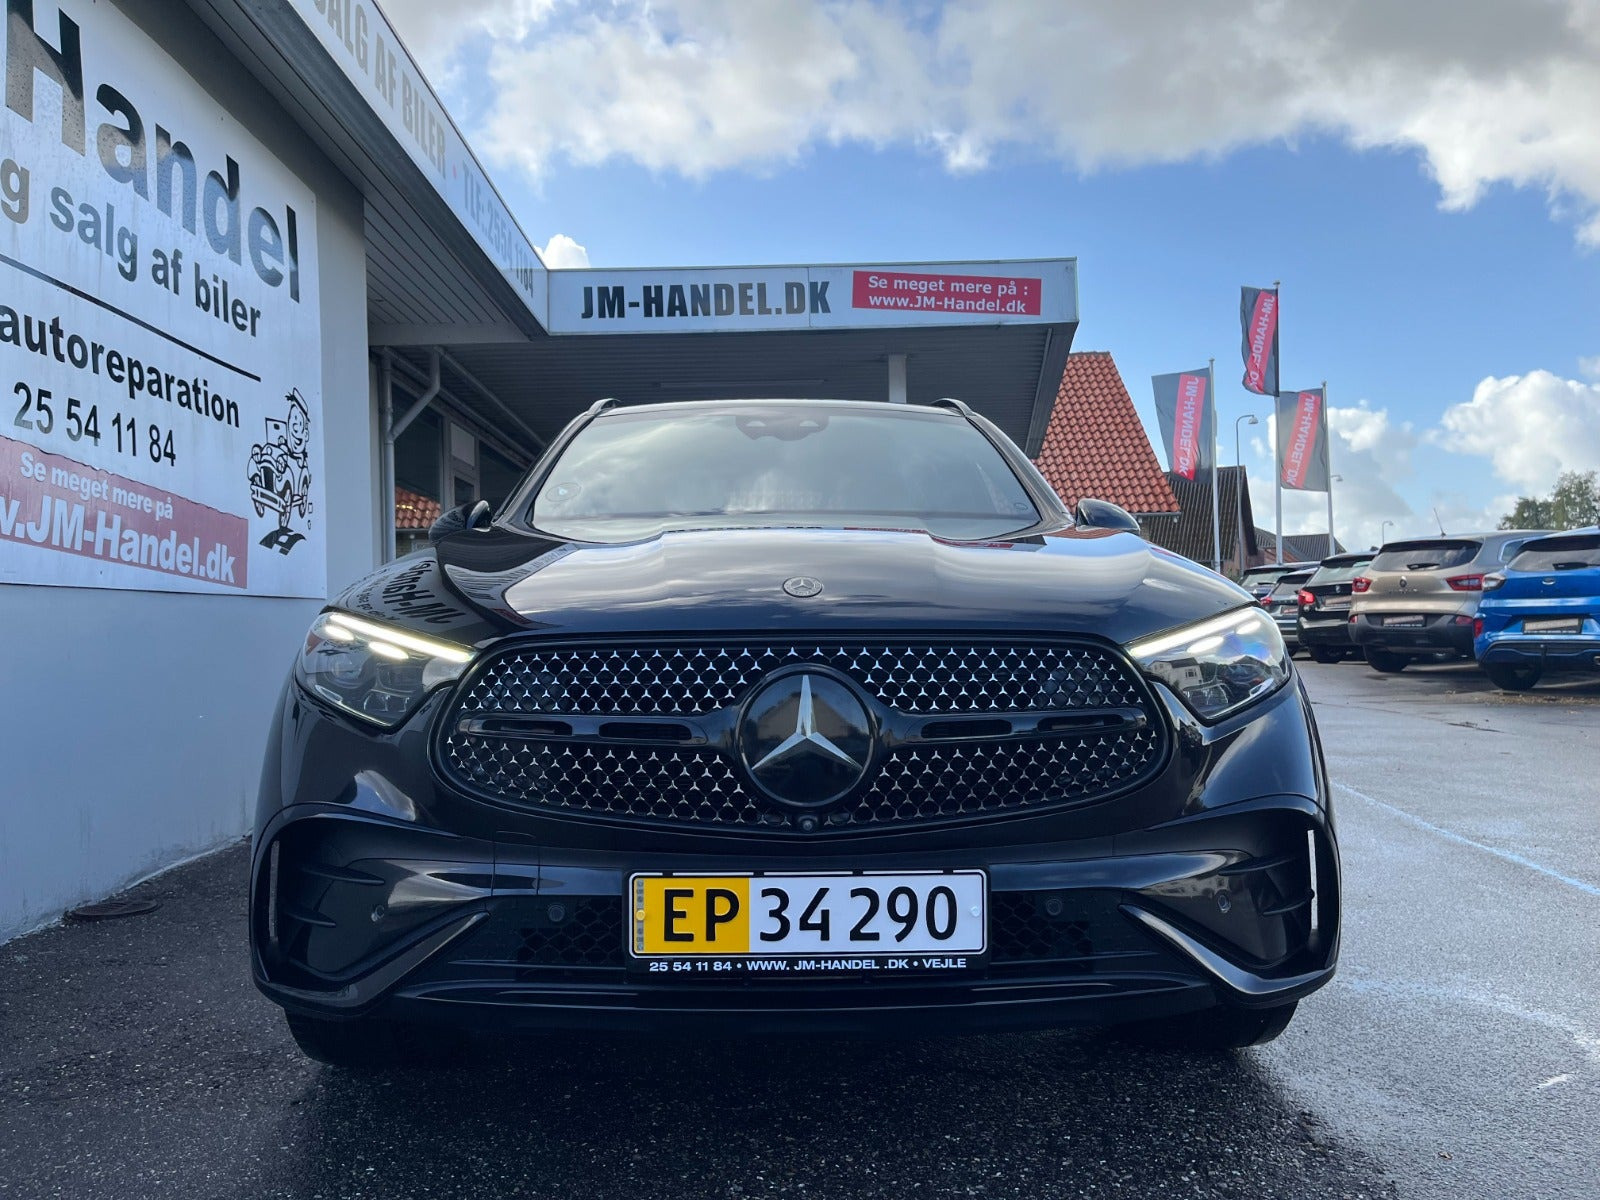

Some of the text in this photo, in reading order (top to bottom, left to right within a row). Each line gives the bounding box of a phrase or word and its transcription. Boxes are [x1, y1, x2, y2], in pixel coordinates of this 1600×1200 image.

[313, 0, 369, 76] ALG
[374, 32, 397, 109] AF
[402, 70, 446, 180] BILER
[49, 186, 139, 282] salg
[151, 248, 183, 296] af
[194, 262, 262, 338] biler
[868, 275, 888, 289] Se
[893, 278, 945, 294] meget
[950, 280, 992, 294] mere
[997, 281, 1017, 297] på
[581, 281, 831, 319] JM-HANDEL.DK
[869, 295, 1026, 313] www.JM-Handel.dk
[0, 304, 240, 428] autoreparation
[13, 381, 176, 467] 25 54 11 84
[20, 452, 173, 520] Se meget mere på
[663, 885, 958, 943] EP 34 290
[649, 961, 669, 972] 25
[672, 961, 692, 972] 54
[695, 961, 709, 971] 11
[713, 961, 732, 972] 84
[746, 960, 790, 971] WWW.
[793, 958, 879, 971] JM-HANDEL
[922, 957, 967, 969] VEJLE
